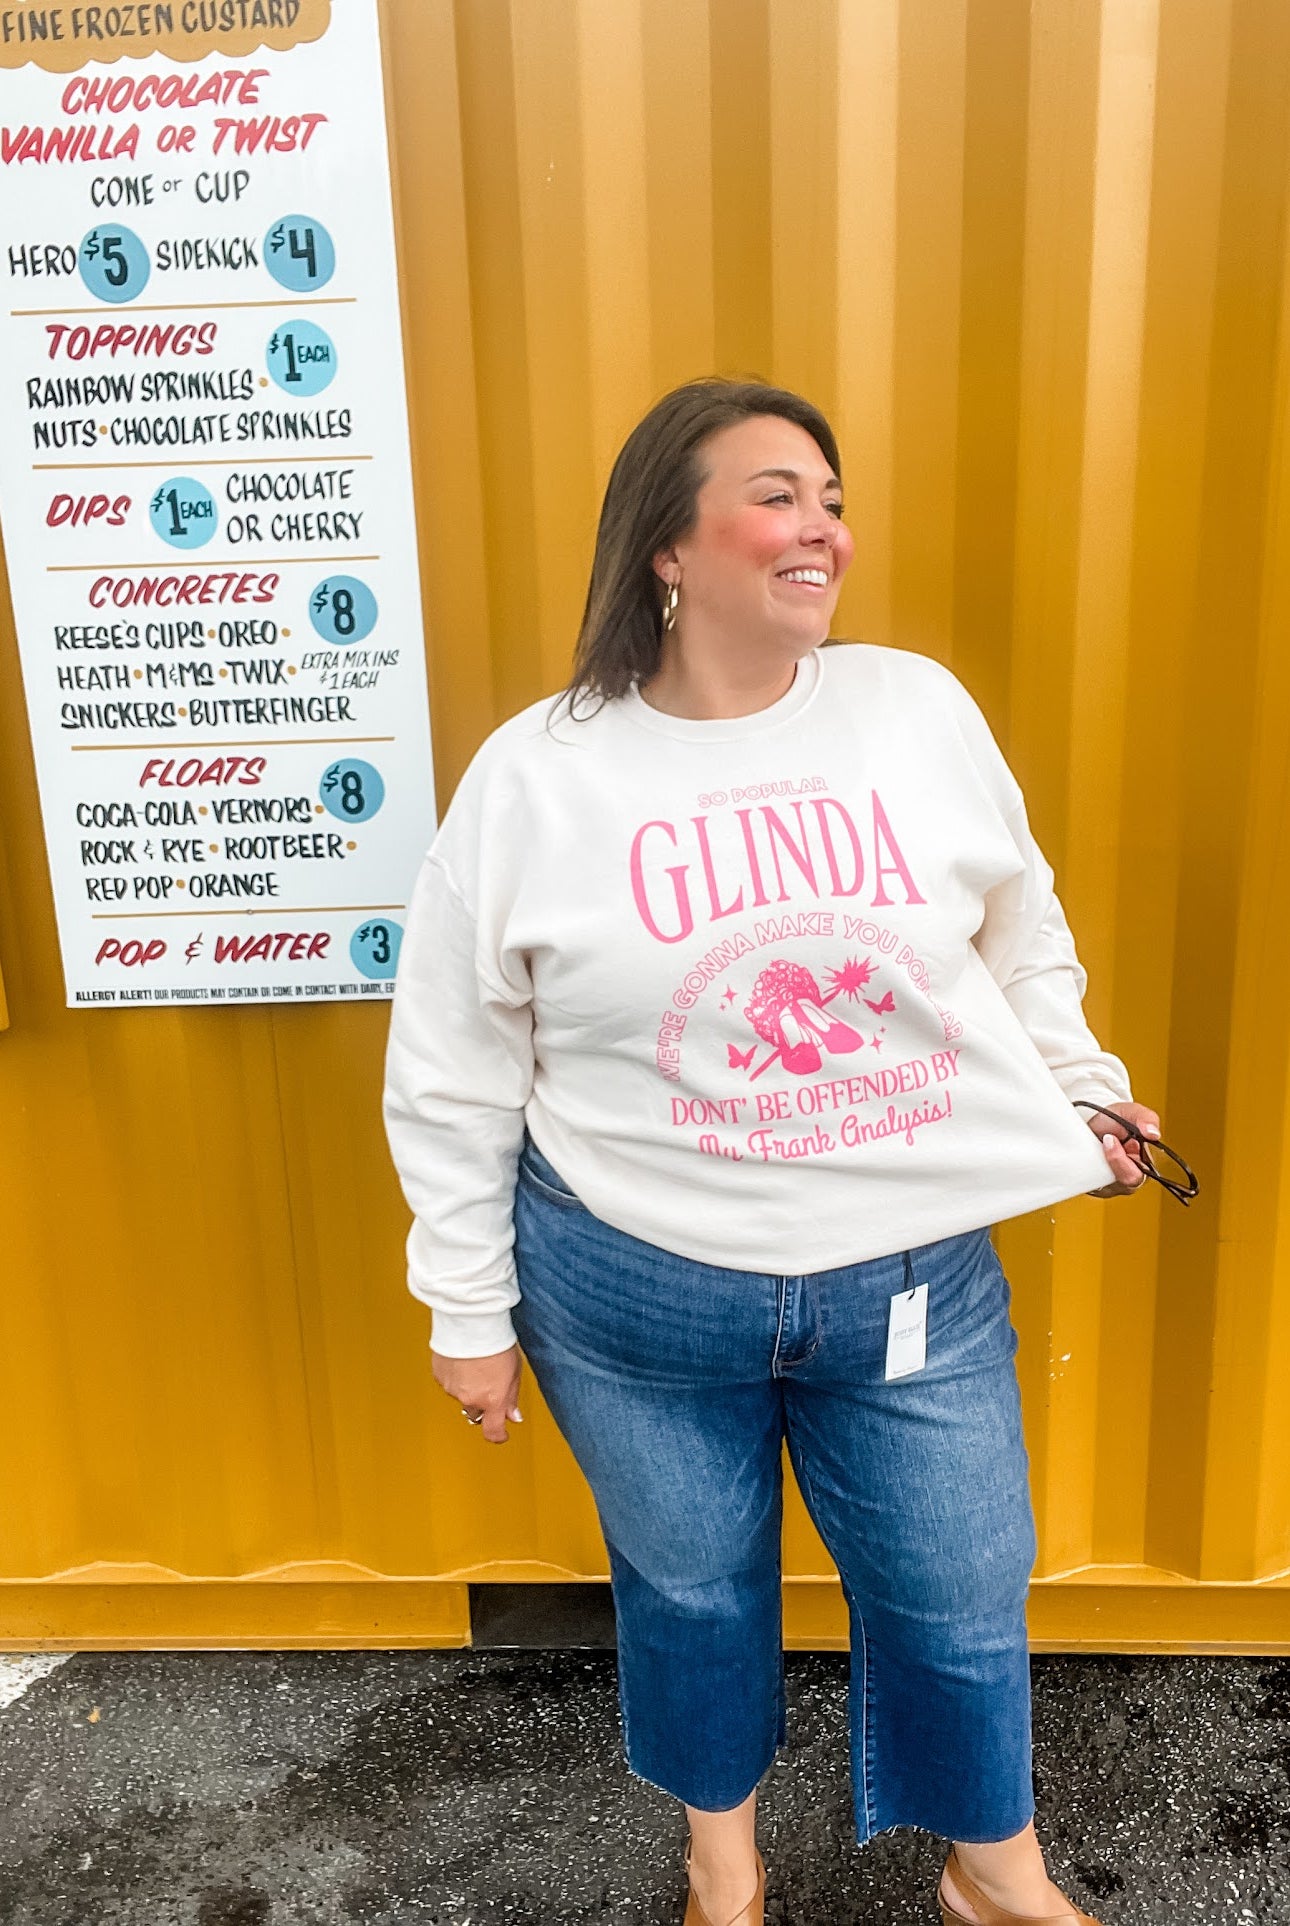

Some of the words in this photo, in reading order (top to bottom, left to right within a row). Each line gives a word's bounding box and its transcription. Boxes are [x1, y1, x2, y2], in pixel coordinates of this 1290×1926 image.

[3, 9, 65, 42] FINE
[72, 5, 173, 40] FROZEN
[181, 0, 300, 33] CUSTARD
[61, 68, 270, 115] CHOCOLATE
[1, 124, 140, 165] VANILLA
[157, 125, 196, 153] OR
[212, 113, 328, 156] TWIST
[91, 173, 154, 208] CONE
[196, 170, 250, 203] CUP
[9, 244, 76, 277] HERO
[84, 231, 128, 286] $5
[156, 237, 259, 271] SIDEKICK
[270, 224, 317, 278] $4
[45, 322, 218, 360] TOPPINGS
[297, 345, 329, 363] EACH
[26, 371, 135, 409] RAINBOW
[141, 369, 254, 401] SPRINKLES
[33, 419, 96, 449] NUTS
[110, 414, 231, 446] CHOCOLATE
[237, 409, 352, 440] SPRINKLES
[226, 469, 355, 503] CHOCOLATE
[45, 494, 132, 527] DIPS
[181, 500, 213, 518] EACH
[227, 516, 262, 544] OR
[271, 511, 364, 541] CHERRY
[88, 573, 279, 608] CONCRETES
[313, 583, 355, 635] $8
[145, 621, 206, 649] CUPS
[218, 620, 277, 647] OREO
[56, 665, 130, 692] HEATH
[146, 661, 215, 689] M&MS
[226, 658, 289, 686] TWIX
[301, 651, 339, 669] EXTRA
[342, 650, 371, 668] MIX
[341, 670, 380, 689] EACH
[61, 701, 177, 730] SNICKERS
[189, 696, 356, 727] BUTTERFINGER
[139, 756, 267, 789] FLOATS
[323, 765, 365, 815] $8
[698, 791, 727, 808] SO
[731, 776, 828, 803] POPULAR
[76, 800, 197, 828] COCA-COLA
[212, 797, 313, 824] VERNORS
[81, 840, 136, 866] ROCK
[143, 839, 154, 860] &
[161, 838, 206, 864] RYE
[630, 789, 927, 944] GLINDA
[86, 877, 128, 902] RED
[133, 875, 174, 900] POP
[189, 872, 281, 898] ORANGE
[95, 937, 168, 967] POP
[184, 932, 205, 965] &
[214, 932, 331, 965] WATER
[357, 925, 391, 964] $3
[672, 933, 754, 1010] GONNA
[754, 912, 834, 946] MAKE
[843, 914, 899, 953] YOU
[76, 991, 116, 1001] ALLERGY
[120, 990, 152, 1000] ALERT!
[154, 989, 169, 1000] OUR
[171, 988, 209, 999] PRODUCTS
[211, 988, 226, 998] MAY
[228, 987, 259, 998] CONTAIN
[261, 986, 271, 997] OR
[273, 986, 294, 997] COME
[295, 985, 303, 996] IN
[305, 984, 337, 995] CONTACT
[339, 983, 358, 994] WITH
[755, 1091, 792, 1121] BE
[797, 1059, 929, 1115] OFFENDED
[934, 1048, 963, 1080] BY
[747, 1124, 835, 1162] Frank
[841, 1095, 953, 1146] Analysis!
